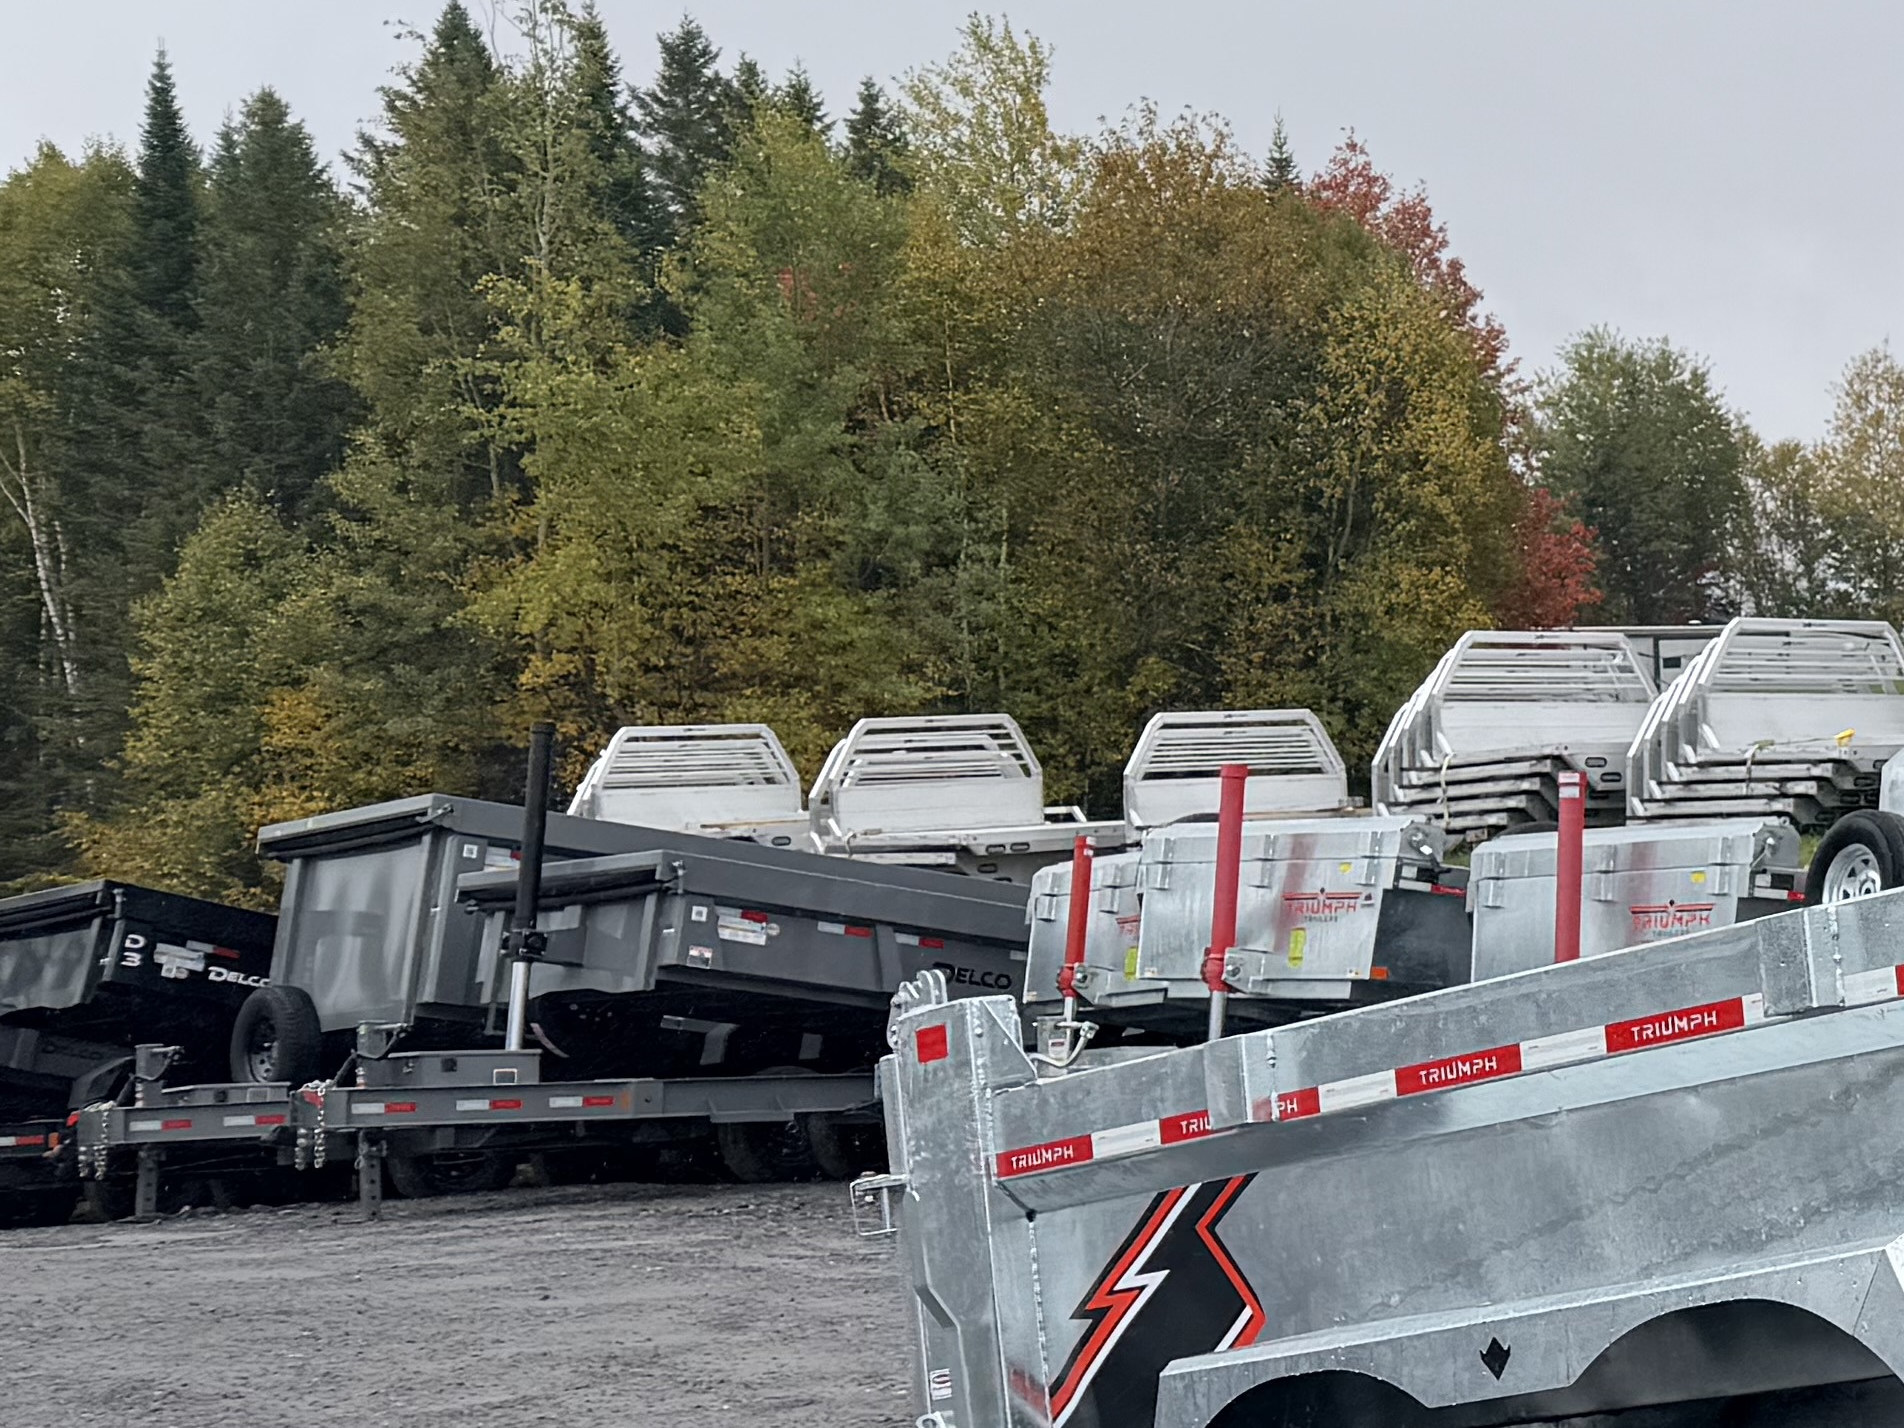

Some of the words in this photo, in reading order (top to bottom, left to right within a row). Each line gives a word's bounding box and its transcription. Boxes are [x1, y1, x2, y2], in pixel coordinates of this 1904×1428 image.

[1286, 898, 1358, 915] TRIUMPH
[1630, 1010, 1718, 1042] TRIUMPH
[1419, 1055, 1498, 1085] TRIUMPH
[1010, 1145, 1075, 1170] TRIUMPH
